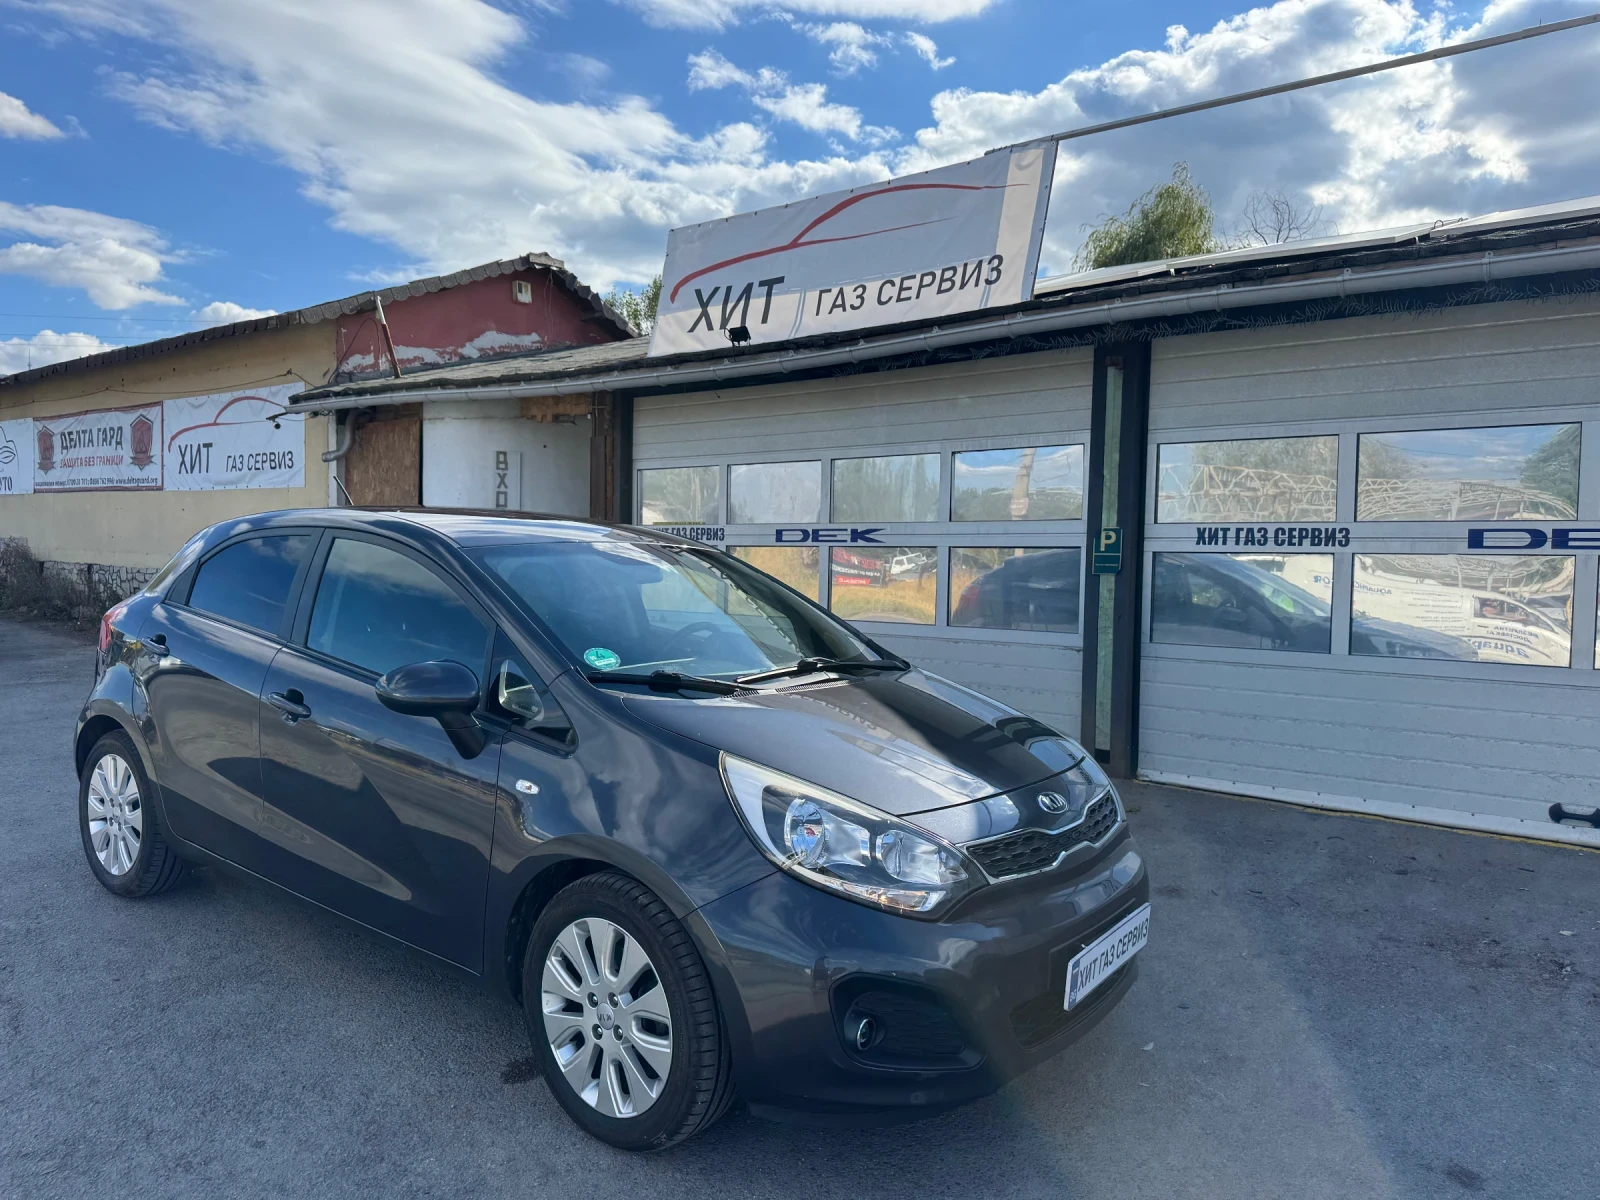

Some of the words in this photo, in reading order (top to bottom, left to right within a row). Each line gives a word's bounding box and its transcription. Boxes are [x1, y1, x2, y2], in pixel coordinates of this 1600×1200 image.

[815, 284, 867, 317] ГАЗ
[877, 254, 1004, 307] СЕРВИЗ
[687, 275, 785, 333] ХИТ
[60, 429, 94, 455] ДЕЛТА
[97, 426, 123, 450] ГАРД
[84, 456, 95, 467] БЕЗ
[178, 442, 213, 475] ХИТ
[226, 454, 244, 473] ГАЗ
[247, 450, 294, 471] СЕРВИЗ
[690, 527, 725, 541] СЕРВИЗ
[775, 528, 886, 543] DEK
[1100, 531, 1117, 551] P
[1196, 527, 1230, 546] ХИТ
[1234, 527, 1268, 547] ГАЗ
[1274, 527, 1350, 548] СЕРВИЗ
[1078, 957, 1098, 992] ХИТ
[1099, 944, 1115, 975] ГАЗ
[1117, 918, 1149, 960] СЕРВИЗ
